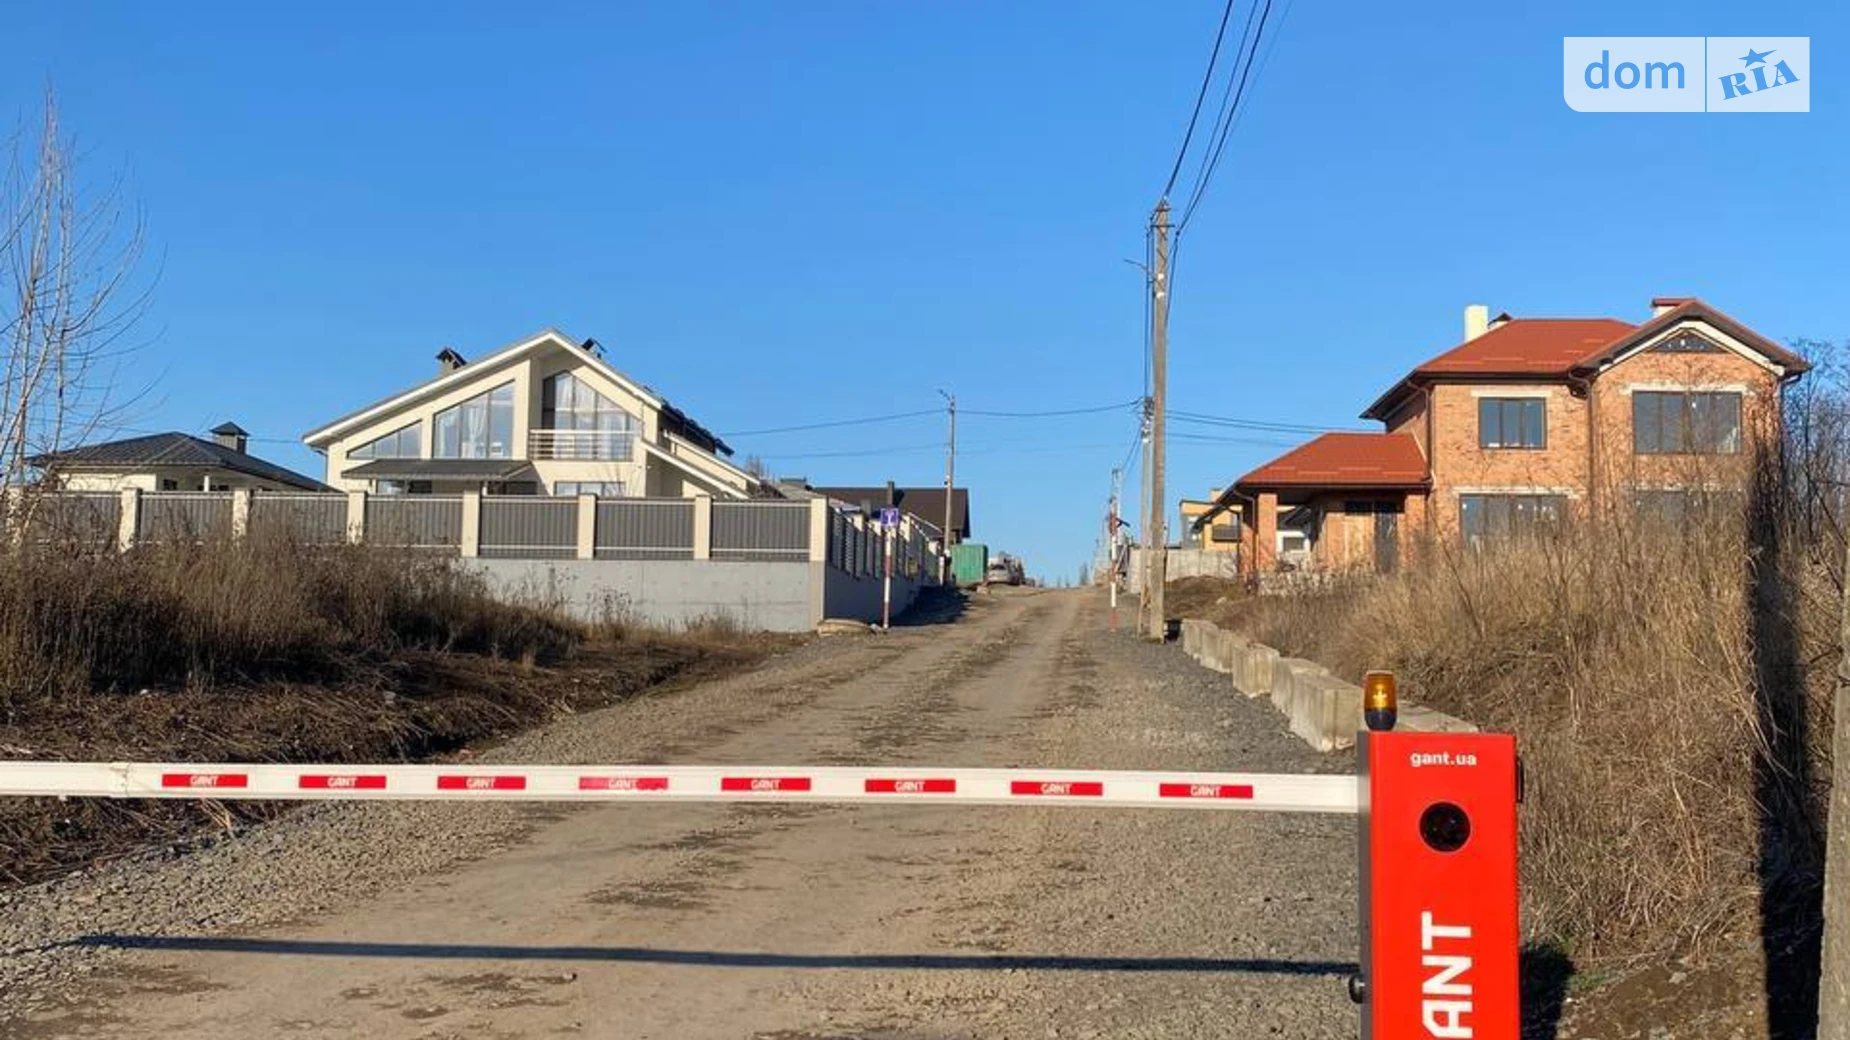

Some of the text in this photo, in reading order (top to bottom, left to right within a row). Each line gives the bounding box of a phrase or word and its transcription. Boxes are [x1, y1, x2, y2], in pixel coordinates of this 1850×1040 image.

[1410, 751, 1477, 767] gant.ua
[190, 775, 219, 787] GANT
[327, 777, 357, 788] GANT
[466, 777, 496, 789] GANT
[751, 779, 781, 790] GANT
[894, 780, 925, 791] GANT
[1041, 783, 1071, 795] GANT
[1190, 785, 1221, 797] GANT
